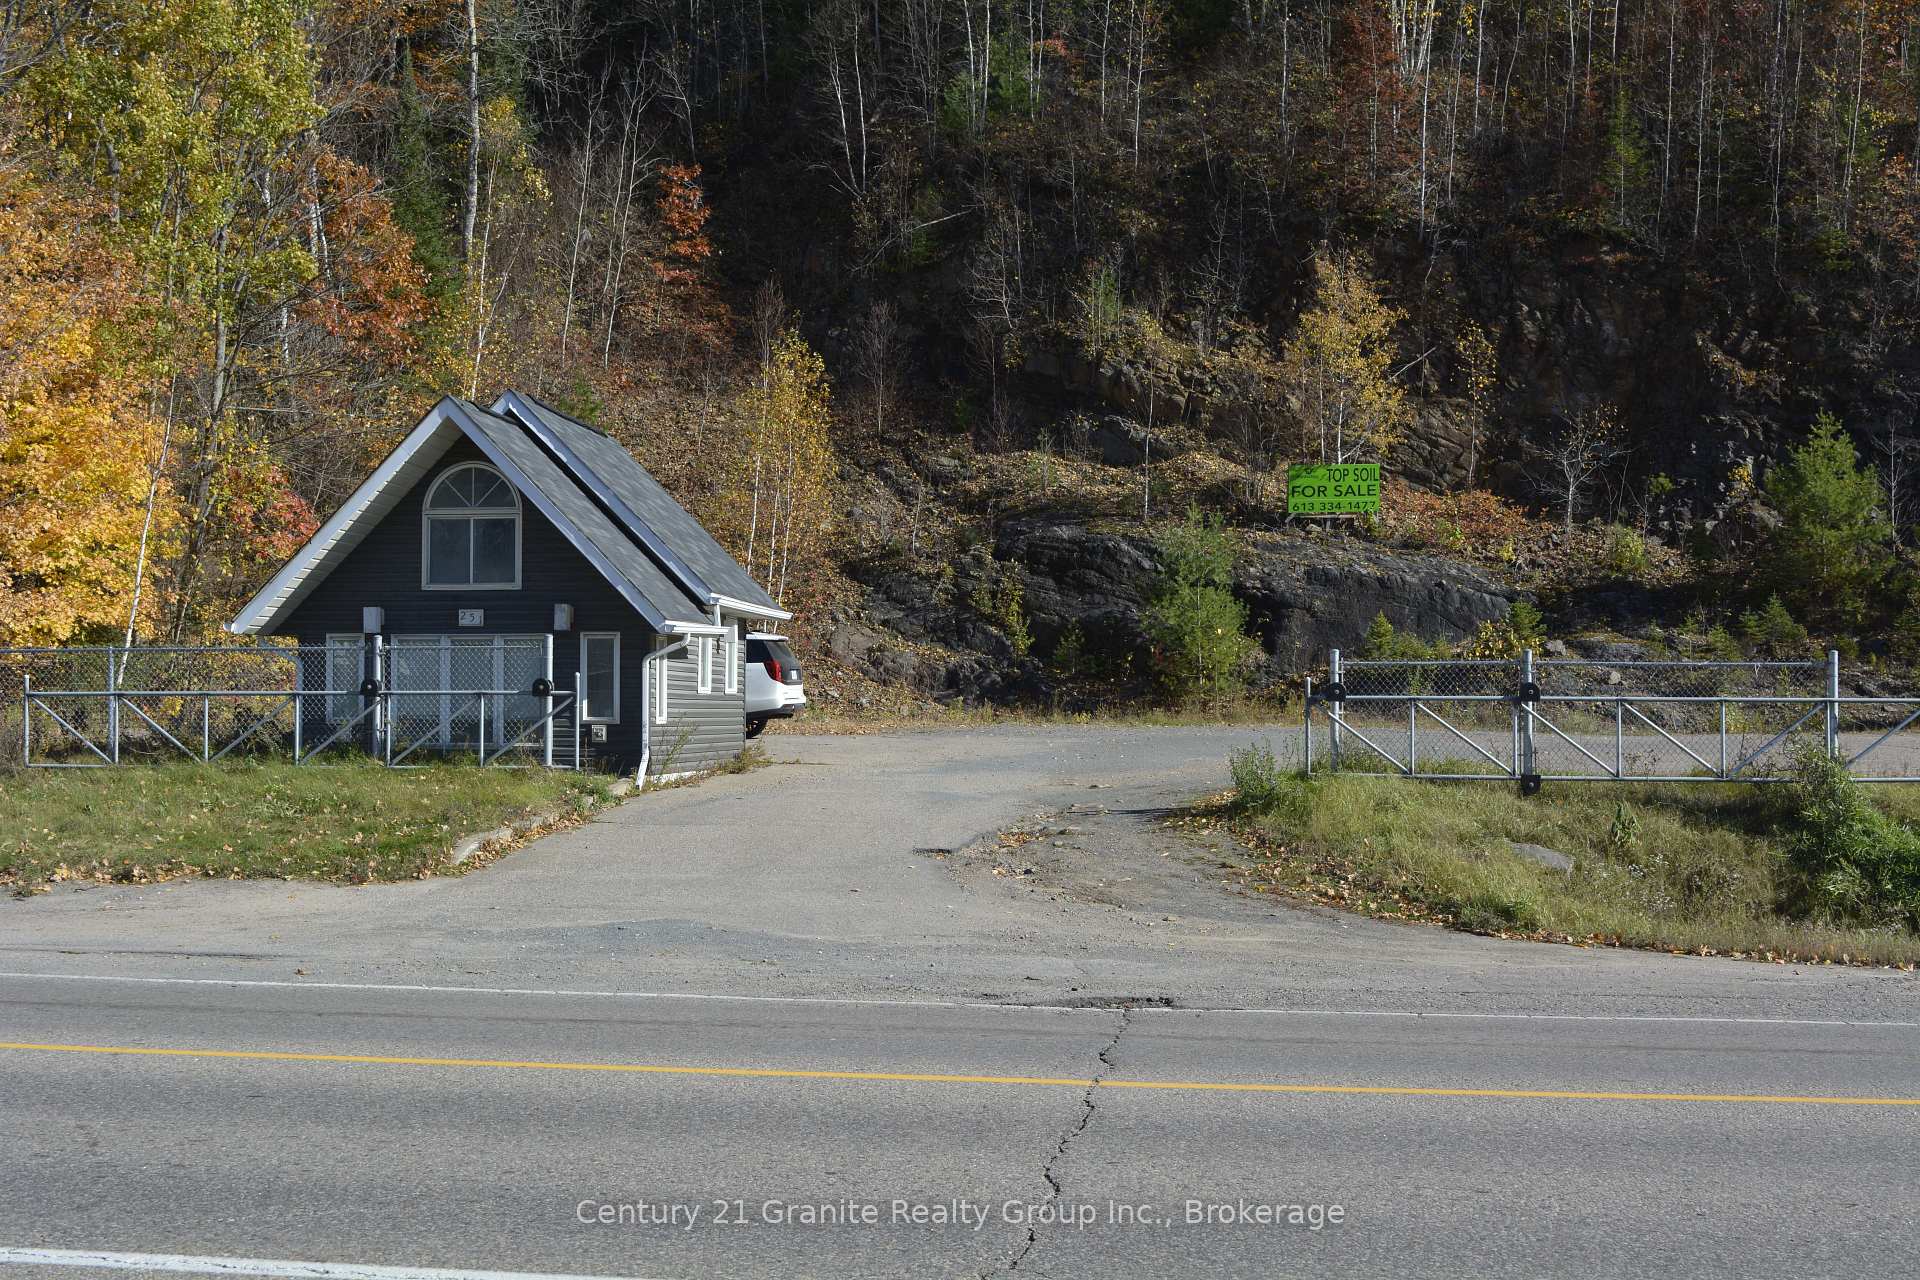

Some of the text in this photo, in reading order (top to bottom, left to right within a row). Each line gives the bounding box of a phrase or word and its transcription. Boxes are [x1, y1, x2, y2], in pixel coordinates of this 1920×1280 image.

[1326, 468, 1379, 482] TOP SOIL
[1291, 484, 1377, 498] FOR SALE
[1292, 501, 1376, 512] 613 334-1477
